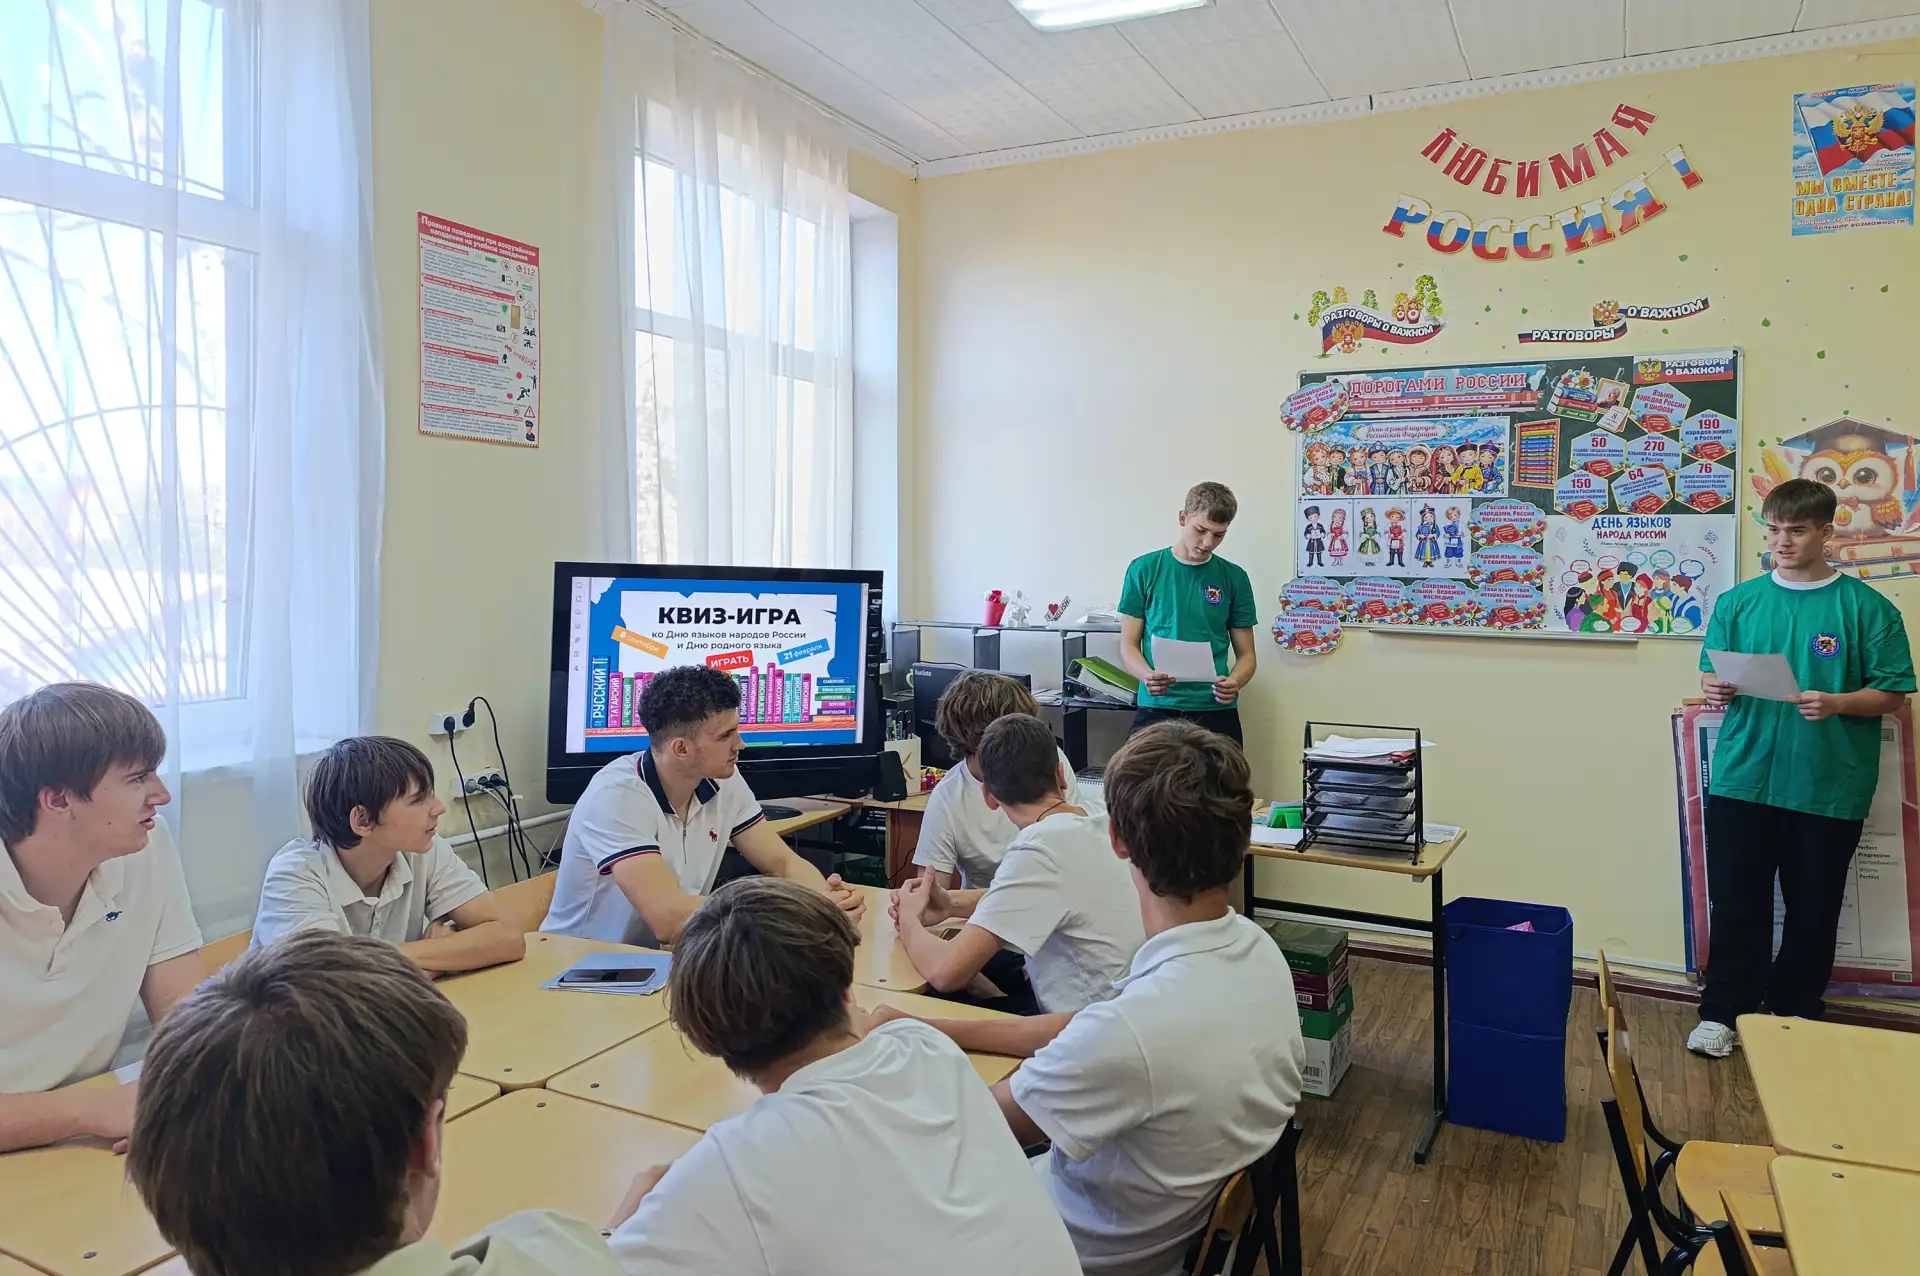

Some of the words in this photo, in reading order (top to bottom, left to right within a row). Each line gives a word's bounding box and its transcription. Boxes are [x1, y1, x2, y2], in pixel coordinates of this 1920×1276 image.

[1420, 103, 1658, 198] ЛЮБИМАЯ
[1795, 178, 1824, 196] МЫ
[1833, 172, 1896, 193] ВМЕСТЕ
[1795, 197, 1836, 217] ОДНА
[1845, 190, 1912, 211] СТРАНА!
[421, 215, 451, 232] Правила
[452, 227, 485, 242] поведения
[523, 267, 536, 276] 112
[1628, 306, 1638, 317] О
[1639, 299, 1704, 319] ВАЖНОМ
[1323, 308, 1381, 329] РАЗГОВОРЫ
[1382, 323, 1390, 332] О
[1390, 325, 1434, 337] ВАЖНОМ
[1531, 328, 1615, 341] РАЗГОВОРЫ
[1665, 357, 1729, 368] РАЗГОВОРЫ
[1665, 368, 1673, 376] О
[1675, 366, 1725, 375] ВАЖНОМ
[1350, 376, 1446, 396] ДОРОГАМИ
[1455, 373, 1527, 390] РОССИИ
[1652, 389, 1674, 399] Языки
[1635, 394, 1663, 405] народов
[1663, 398, 1687, 409] России
[1698, 418, 1720, 430] 190
[1591, 437, 1607, 448] 50
[1644, 440, 1665, 451] 270
[1628, 468, 1644, 480] 64
[1698, 463, 1712, 473] 76
[1571, 478, 1591, 488] 150
[1592, 516, 1623, 530] ДЕНЬ
[1626, 516, 1672, 529] ЯЗЫКОВ
[1597, 530, 1632, 540] НАРОДА
[1634, 530, 1667, 539] РОССИИ
[658, 606, 801, 625] КВИЗ-ИГРА
[620, 631, 626, 639] 8
[666, 631, 689, 640] Дню
[691, 631, 727, 639] языков
[729, 631, 770, 640] народов
[772, 631, 806, 639] России
[686, 642, 708, 651] Дню
[711, 642, 752, 651] родного
[710, 655, 750, 668] ИГРАТЬ
[784, 651, 793, 661] 21
[592, 668, 607, 718] РУССКИЙ
[610, 677, 620, 718] ТАТАРСКИЙ
